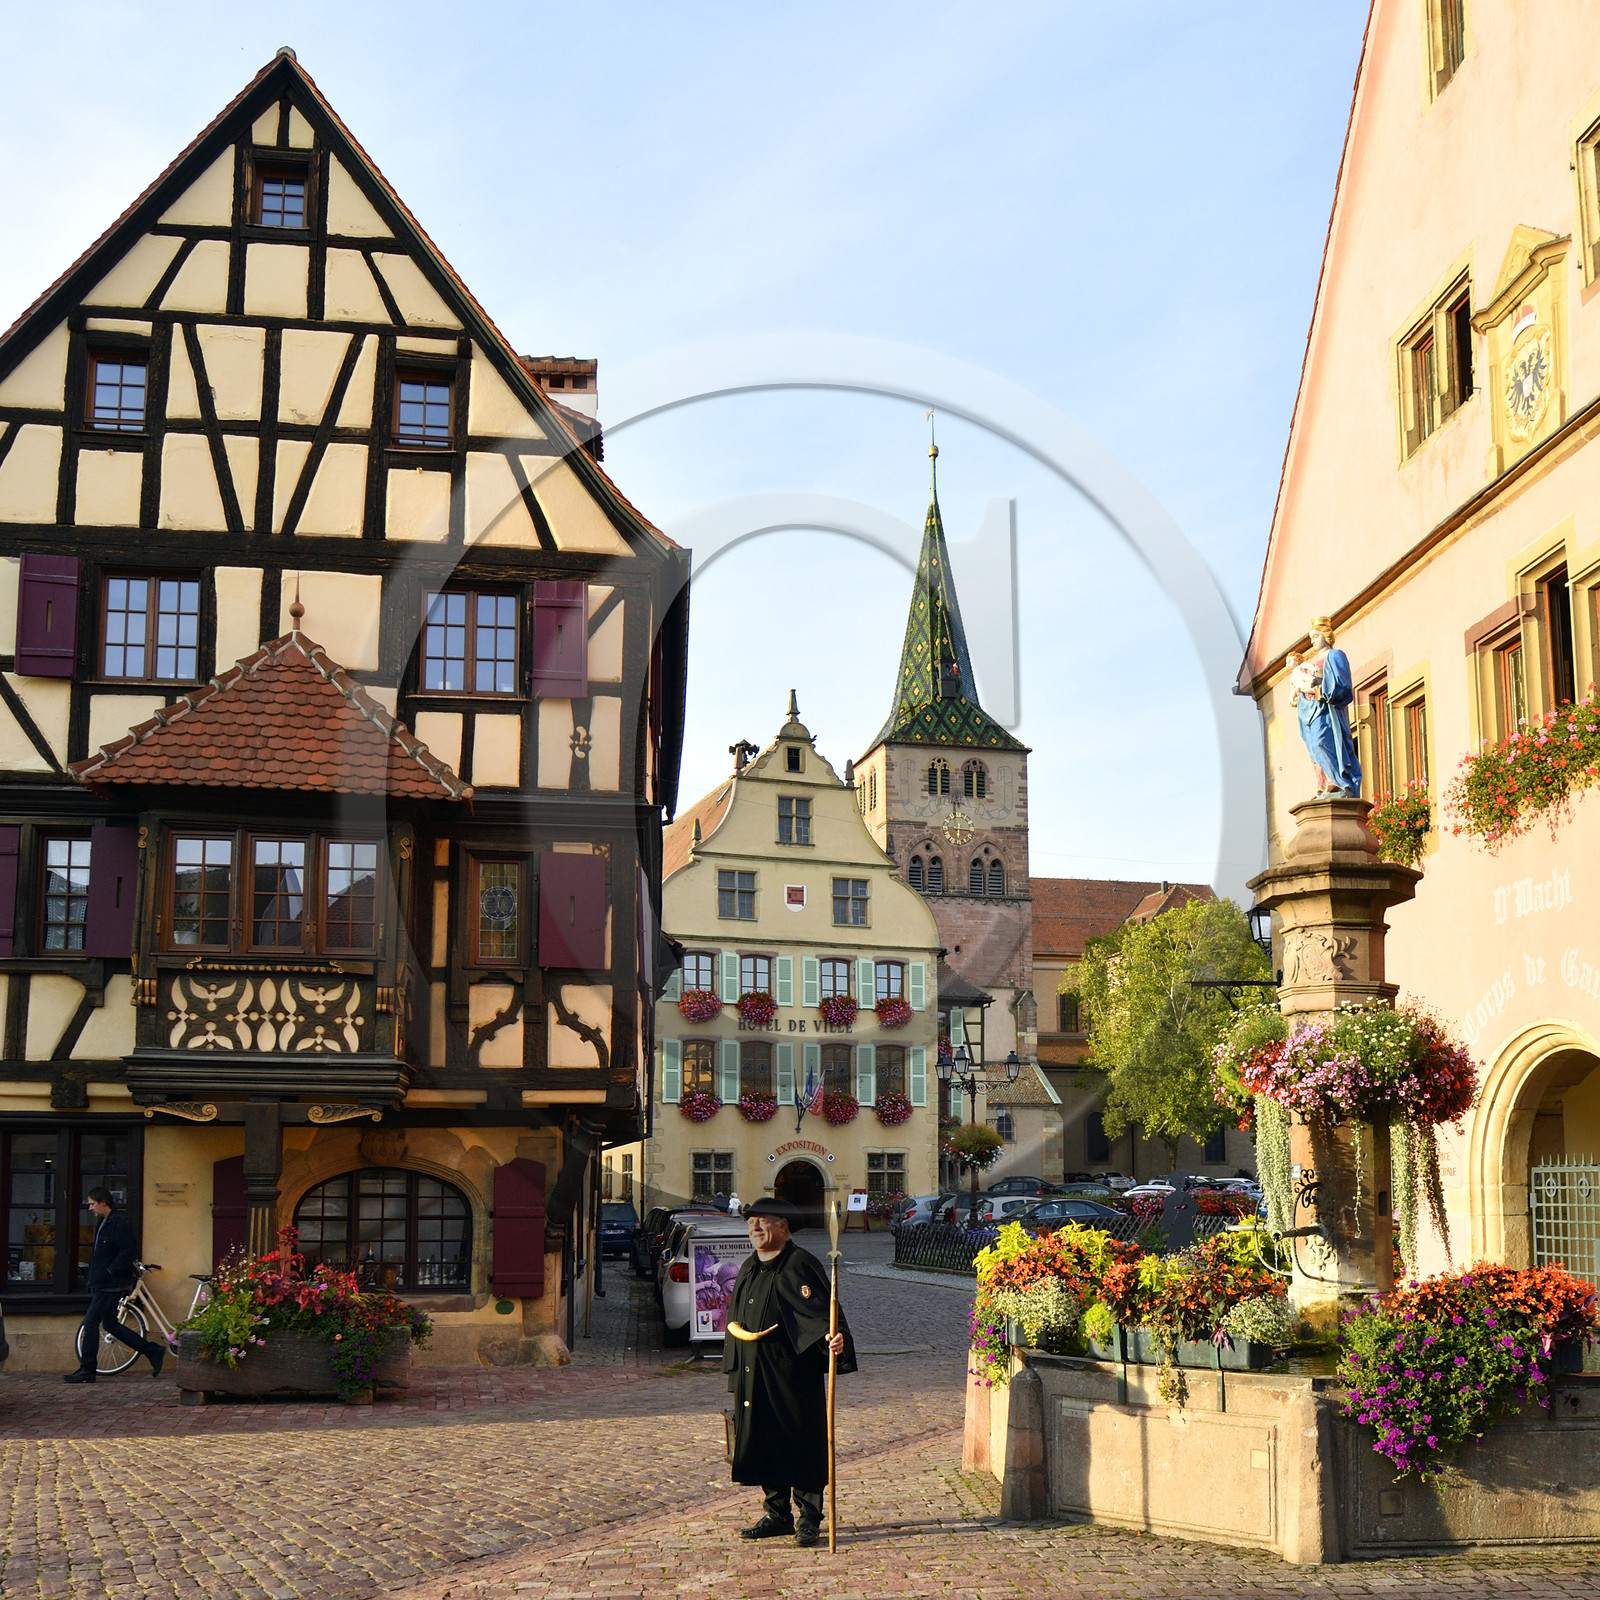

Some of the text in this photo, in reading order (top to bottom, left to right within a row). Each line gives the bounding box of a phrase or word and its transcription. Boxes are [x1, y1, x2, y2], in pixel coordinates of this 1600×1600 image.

[1463, 963, 1516, 1045] Corps
[1523, 951, 1546, 987] de
[788, 1019, 806, 1032] DE
[814, 1020, 853, 1033] VILLE
[775, 1140, 828, 1156] EXPOSITION
